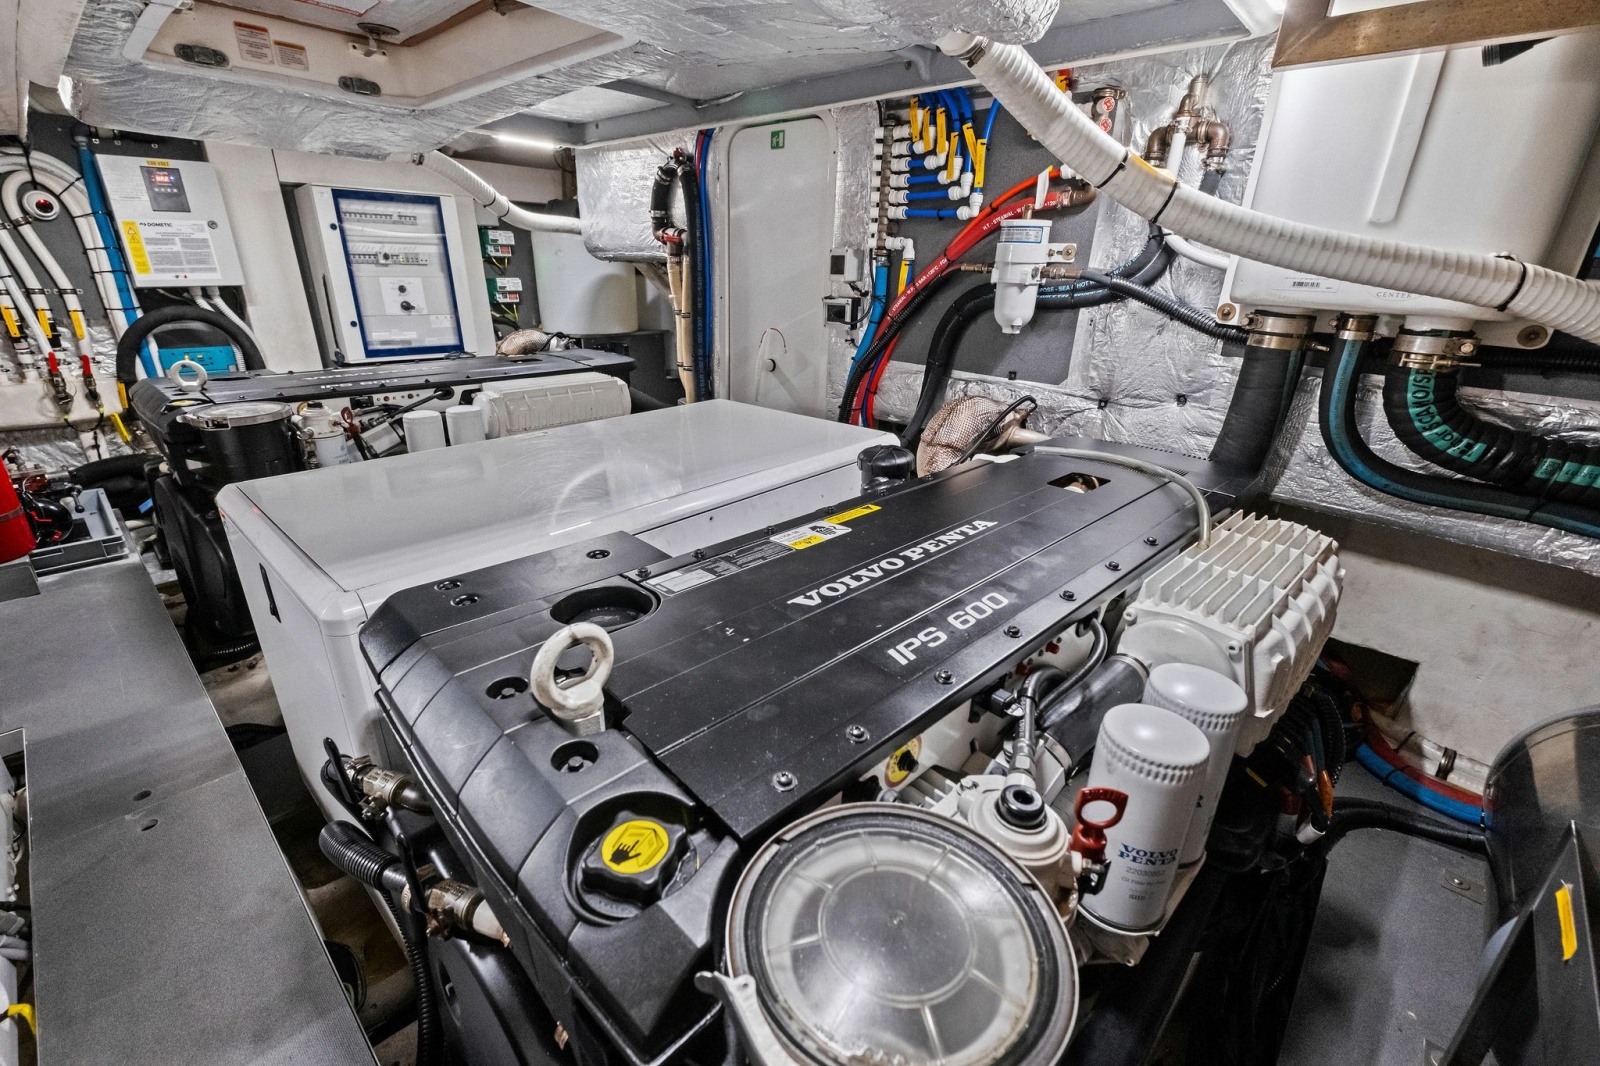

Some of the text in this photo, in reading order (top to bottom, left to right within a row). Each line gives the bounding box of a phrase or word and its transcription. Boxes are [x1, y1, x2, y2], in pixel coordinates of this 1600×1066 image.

[1039, 285, 1055, 293] POSE
[1376, 291, 1412, 299] CENTEK
[787, 519, 998, 607] VOLVO PENTA
[887, 592, 1009, 666] IPS 600
[1118, 849, 1177, 866] PENTA
[1121, 842, 1178, 859] VOLVO
